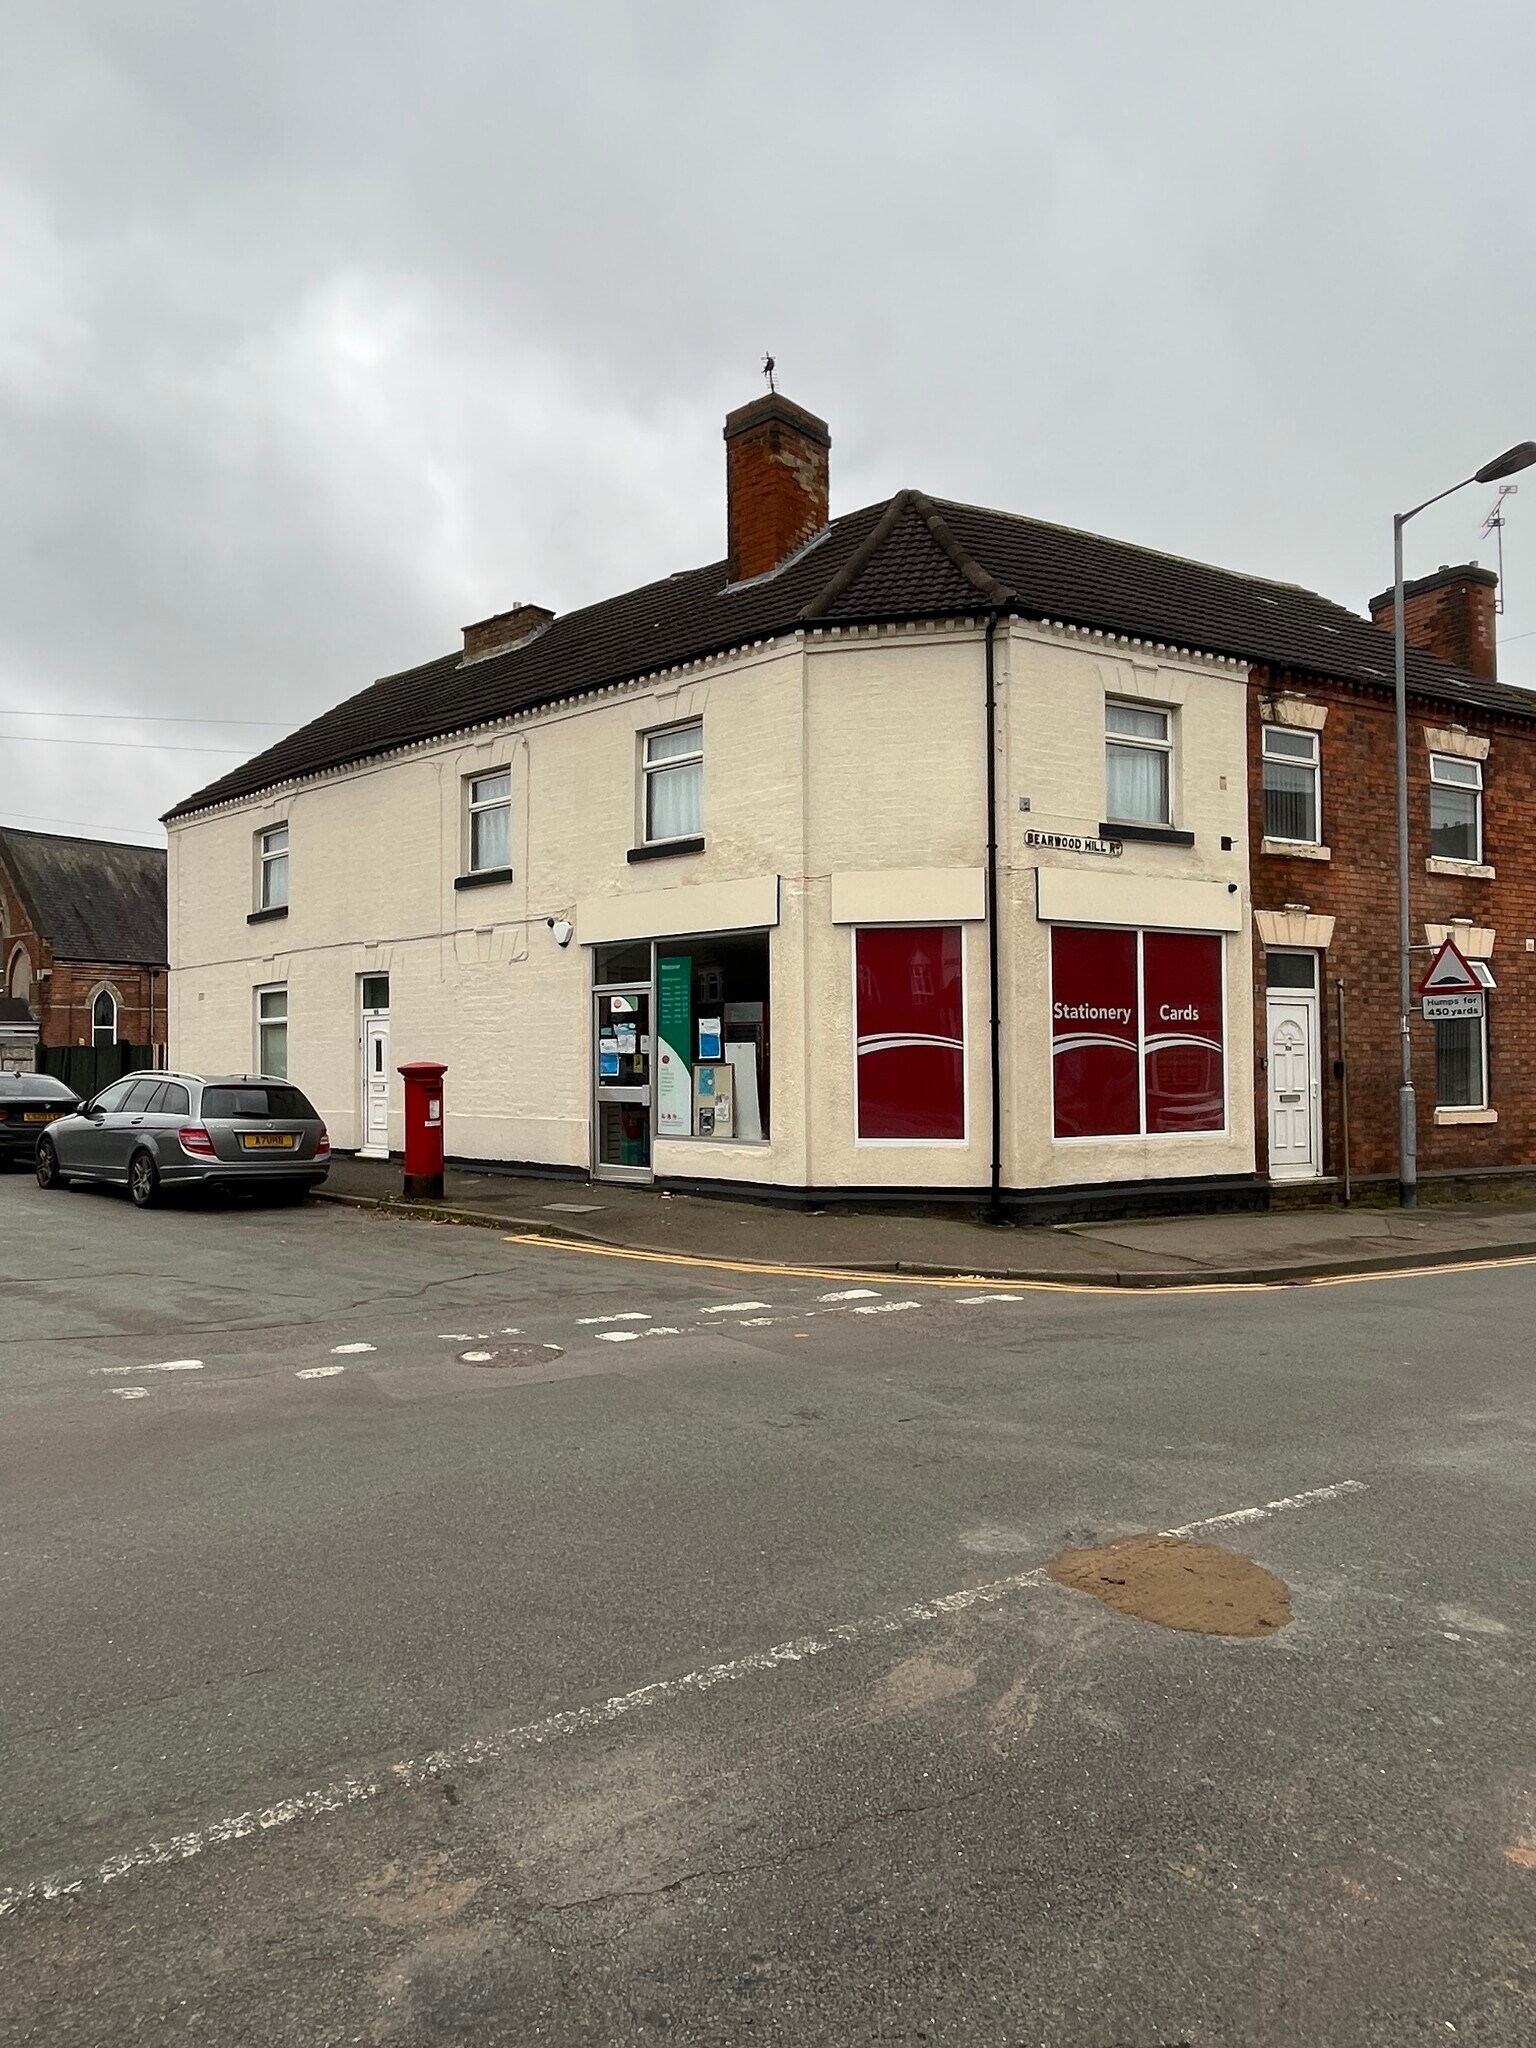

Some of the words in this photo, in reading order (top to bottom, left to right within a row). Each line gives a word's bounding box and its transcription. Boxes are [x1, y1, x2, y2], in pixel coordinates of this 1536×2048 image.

[1027, 832, 1082, 850] BEARWOOD
[1085, 840, 1107, 853] HILL
[1426, 998, 1459, 1006] Humps
[1463, 996, 1477, 1005] for
[1053, 1002, 1132, 1025] Stationery
[1159, 1003, 1200, 1021] Cards
[1428, 1007, 1450, 1015] 450
[1451, 1006, 1479, 1016] yards
